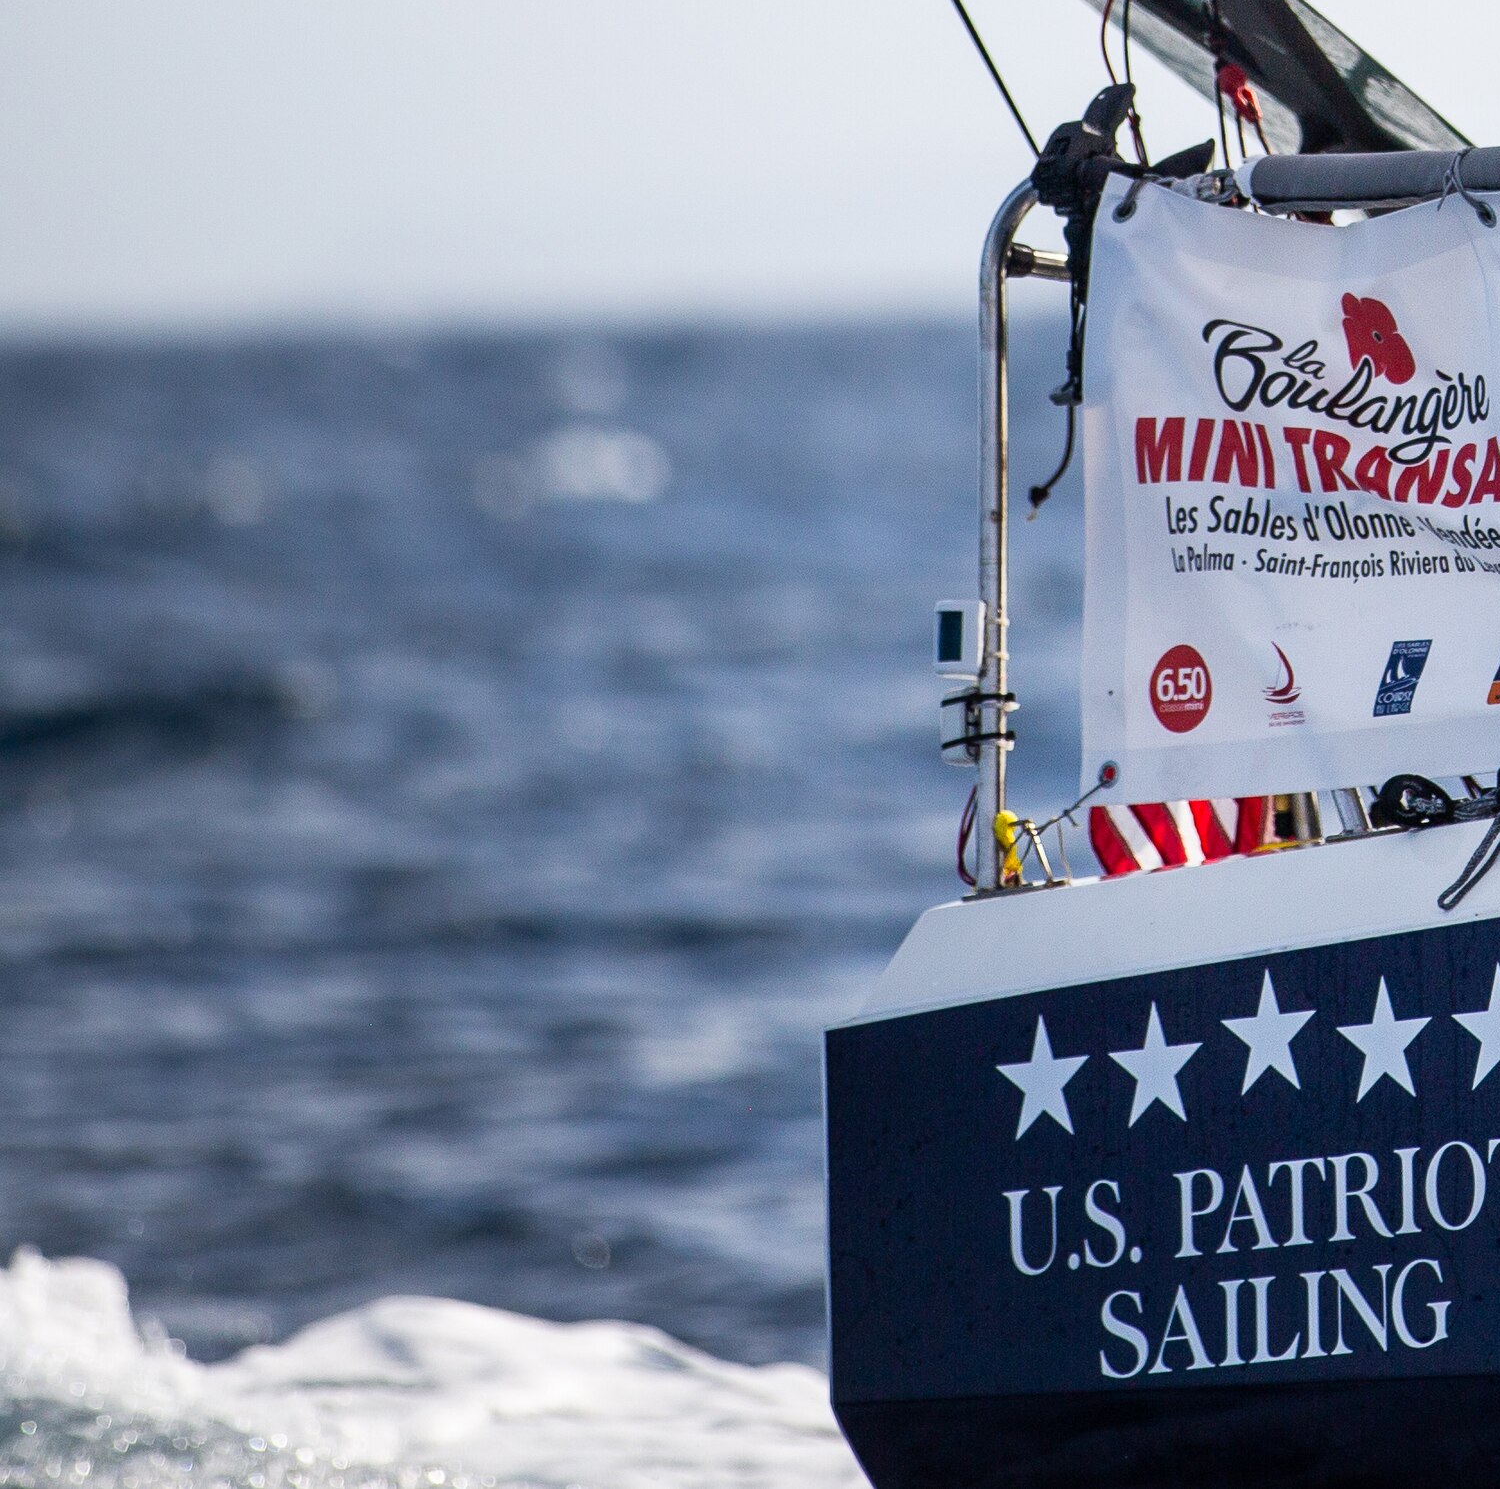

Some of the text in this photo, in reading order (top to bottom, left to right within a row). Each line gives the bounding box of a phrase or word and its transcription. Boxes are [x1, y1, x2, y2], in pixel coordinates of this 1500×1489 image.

[1201, 318, 1490, 465] Boulangère
[1135, 416, 1276, 489] MINI
[1165, 495, 1199, 535] Les
[1207, 495, 1298, 542] Sables
[1302, 500, 1415, 542] d'Olonne
[1187, 543, 1236, 572] Palma
[1254, 548, 1384, 584] Saint-François
[1390, 549, 1450, 577] Riviera
[1453, 548, 1476, 573] du
[1156, 666, 1207, 702] 6.50
[1002, 1179, 1144, 1277] U.S.
[1099, 1258, 1452, 1379] SAILING
